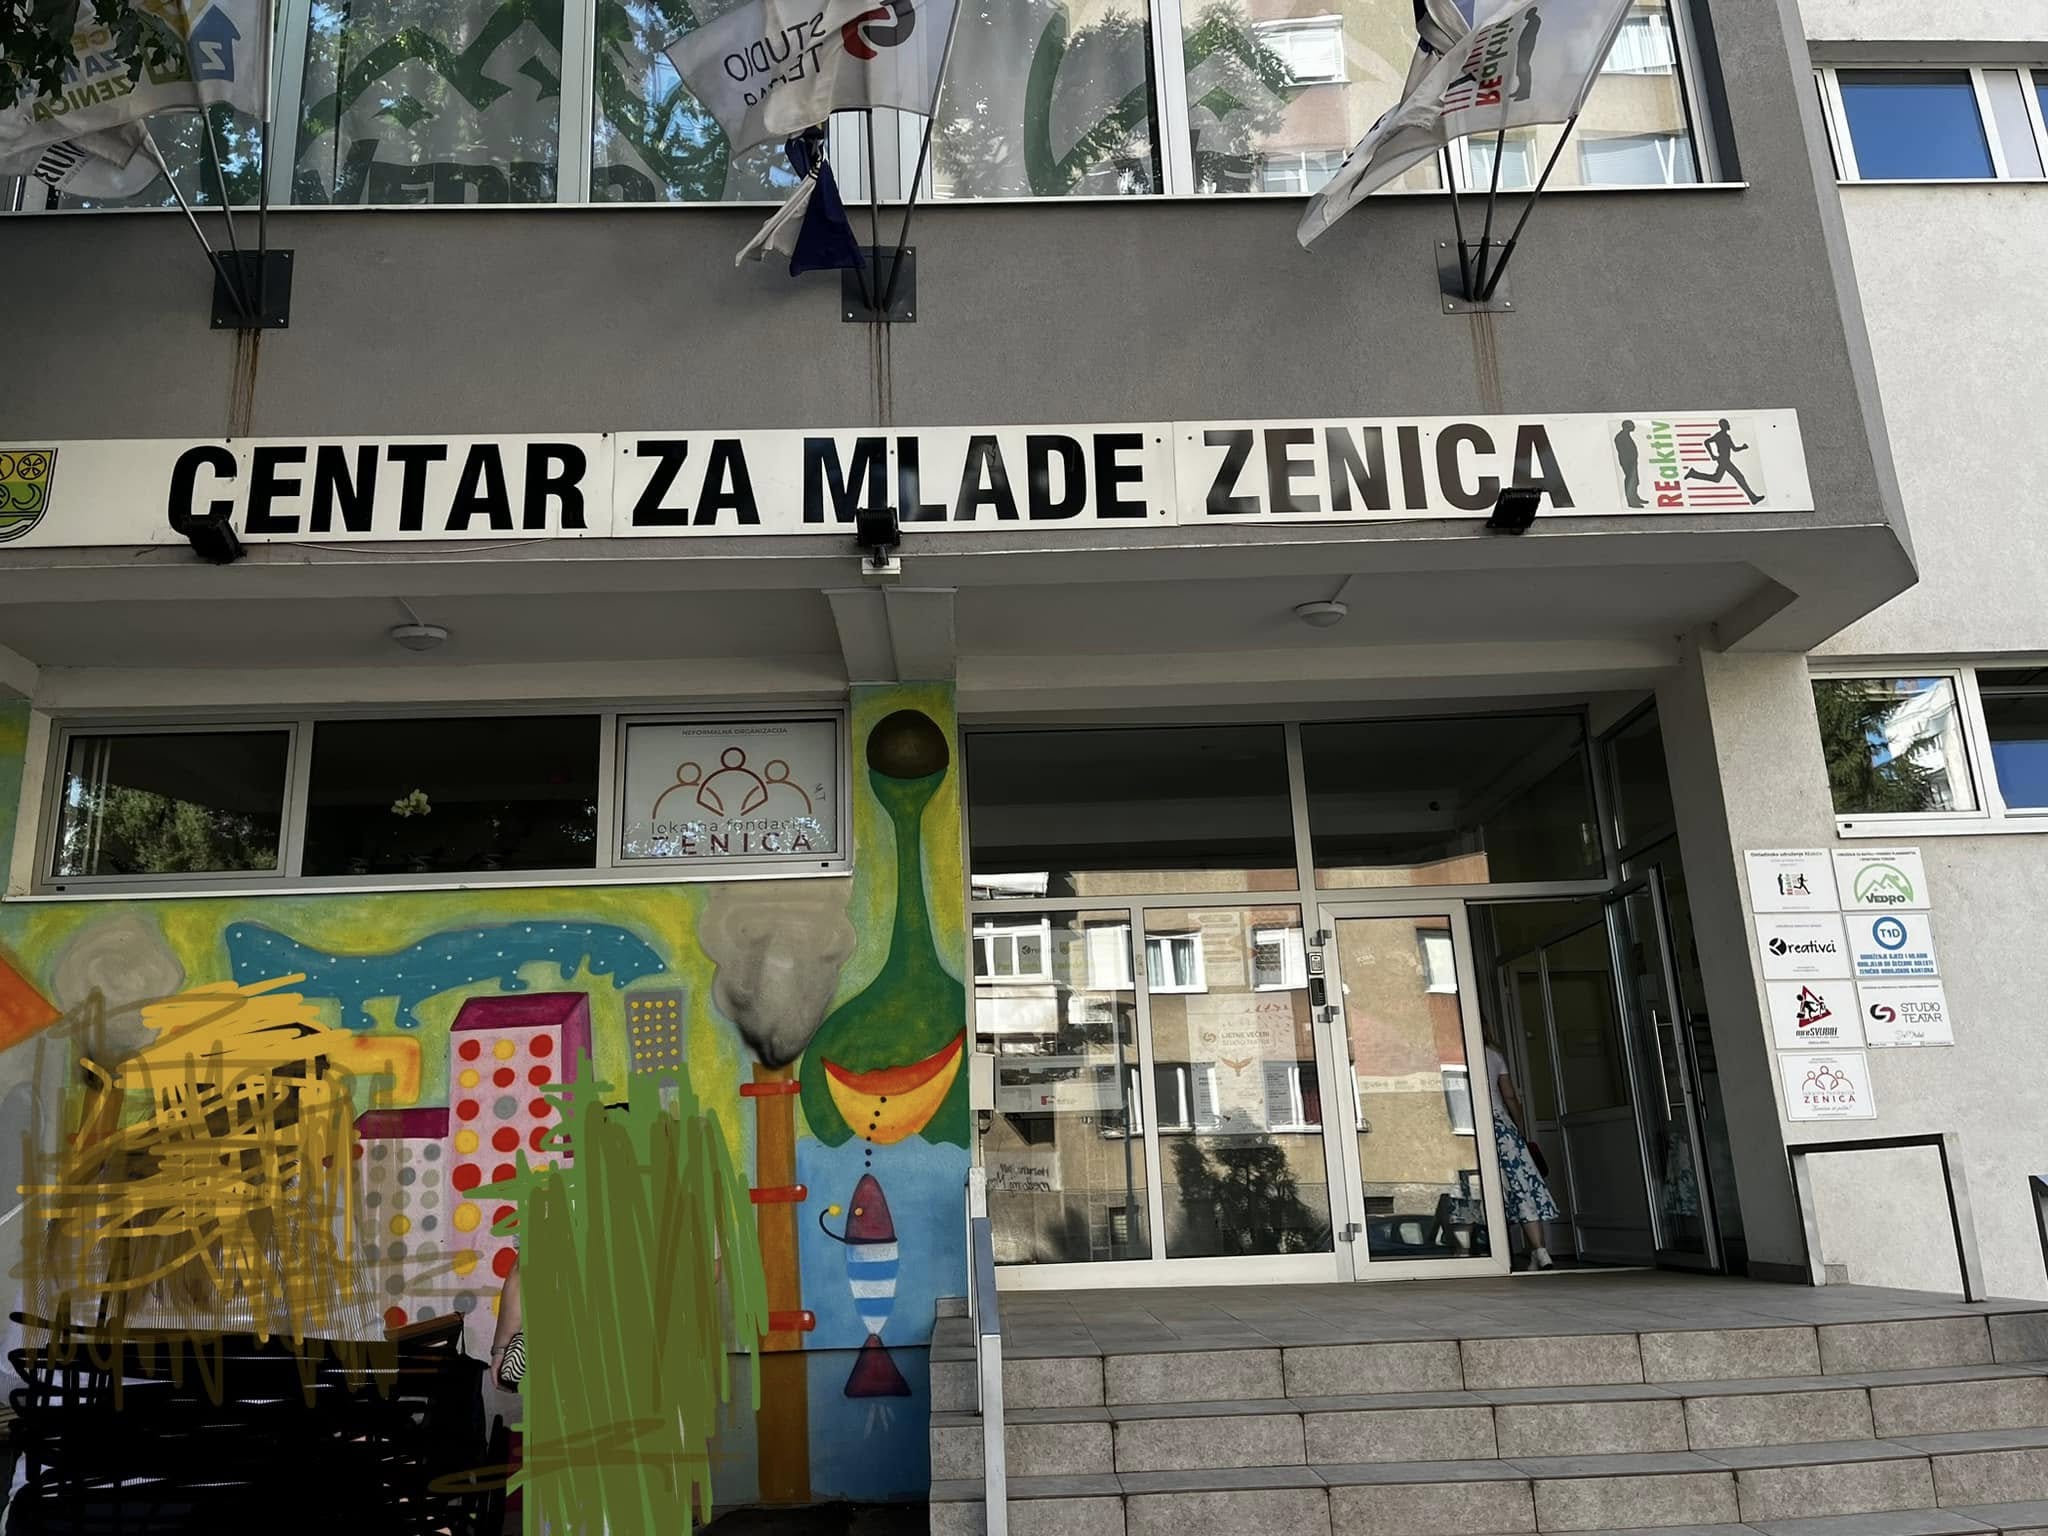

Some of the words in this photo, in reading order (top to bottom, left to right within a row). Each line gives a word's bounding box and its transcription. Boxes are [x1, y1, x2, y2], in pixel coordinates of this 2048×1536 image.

[1647, 421, 1684, 507] REaktiv
[168, 443, 588, 535] CENTAR
[632, 438, 761, 527] ZA
[803, 433, 1148, 523] MLADE
[1204, 423, 1576, 515] ZENICA
[682, 727, 733, 735] NEFORMALNA
[651, 819, 719, 834] lokana
[1880, 928, 1901, 938] T1D
[1900, 1002, 1941, 1013] STUDIO
[1902, 1013, 1943, 1023] TEATAR
[1803, 1094, 1856, 1104] ZENICA
